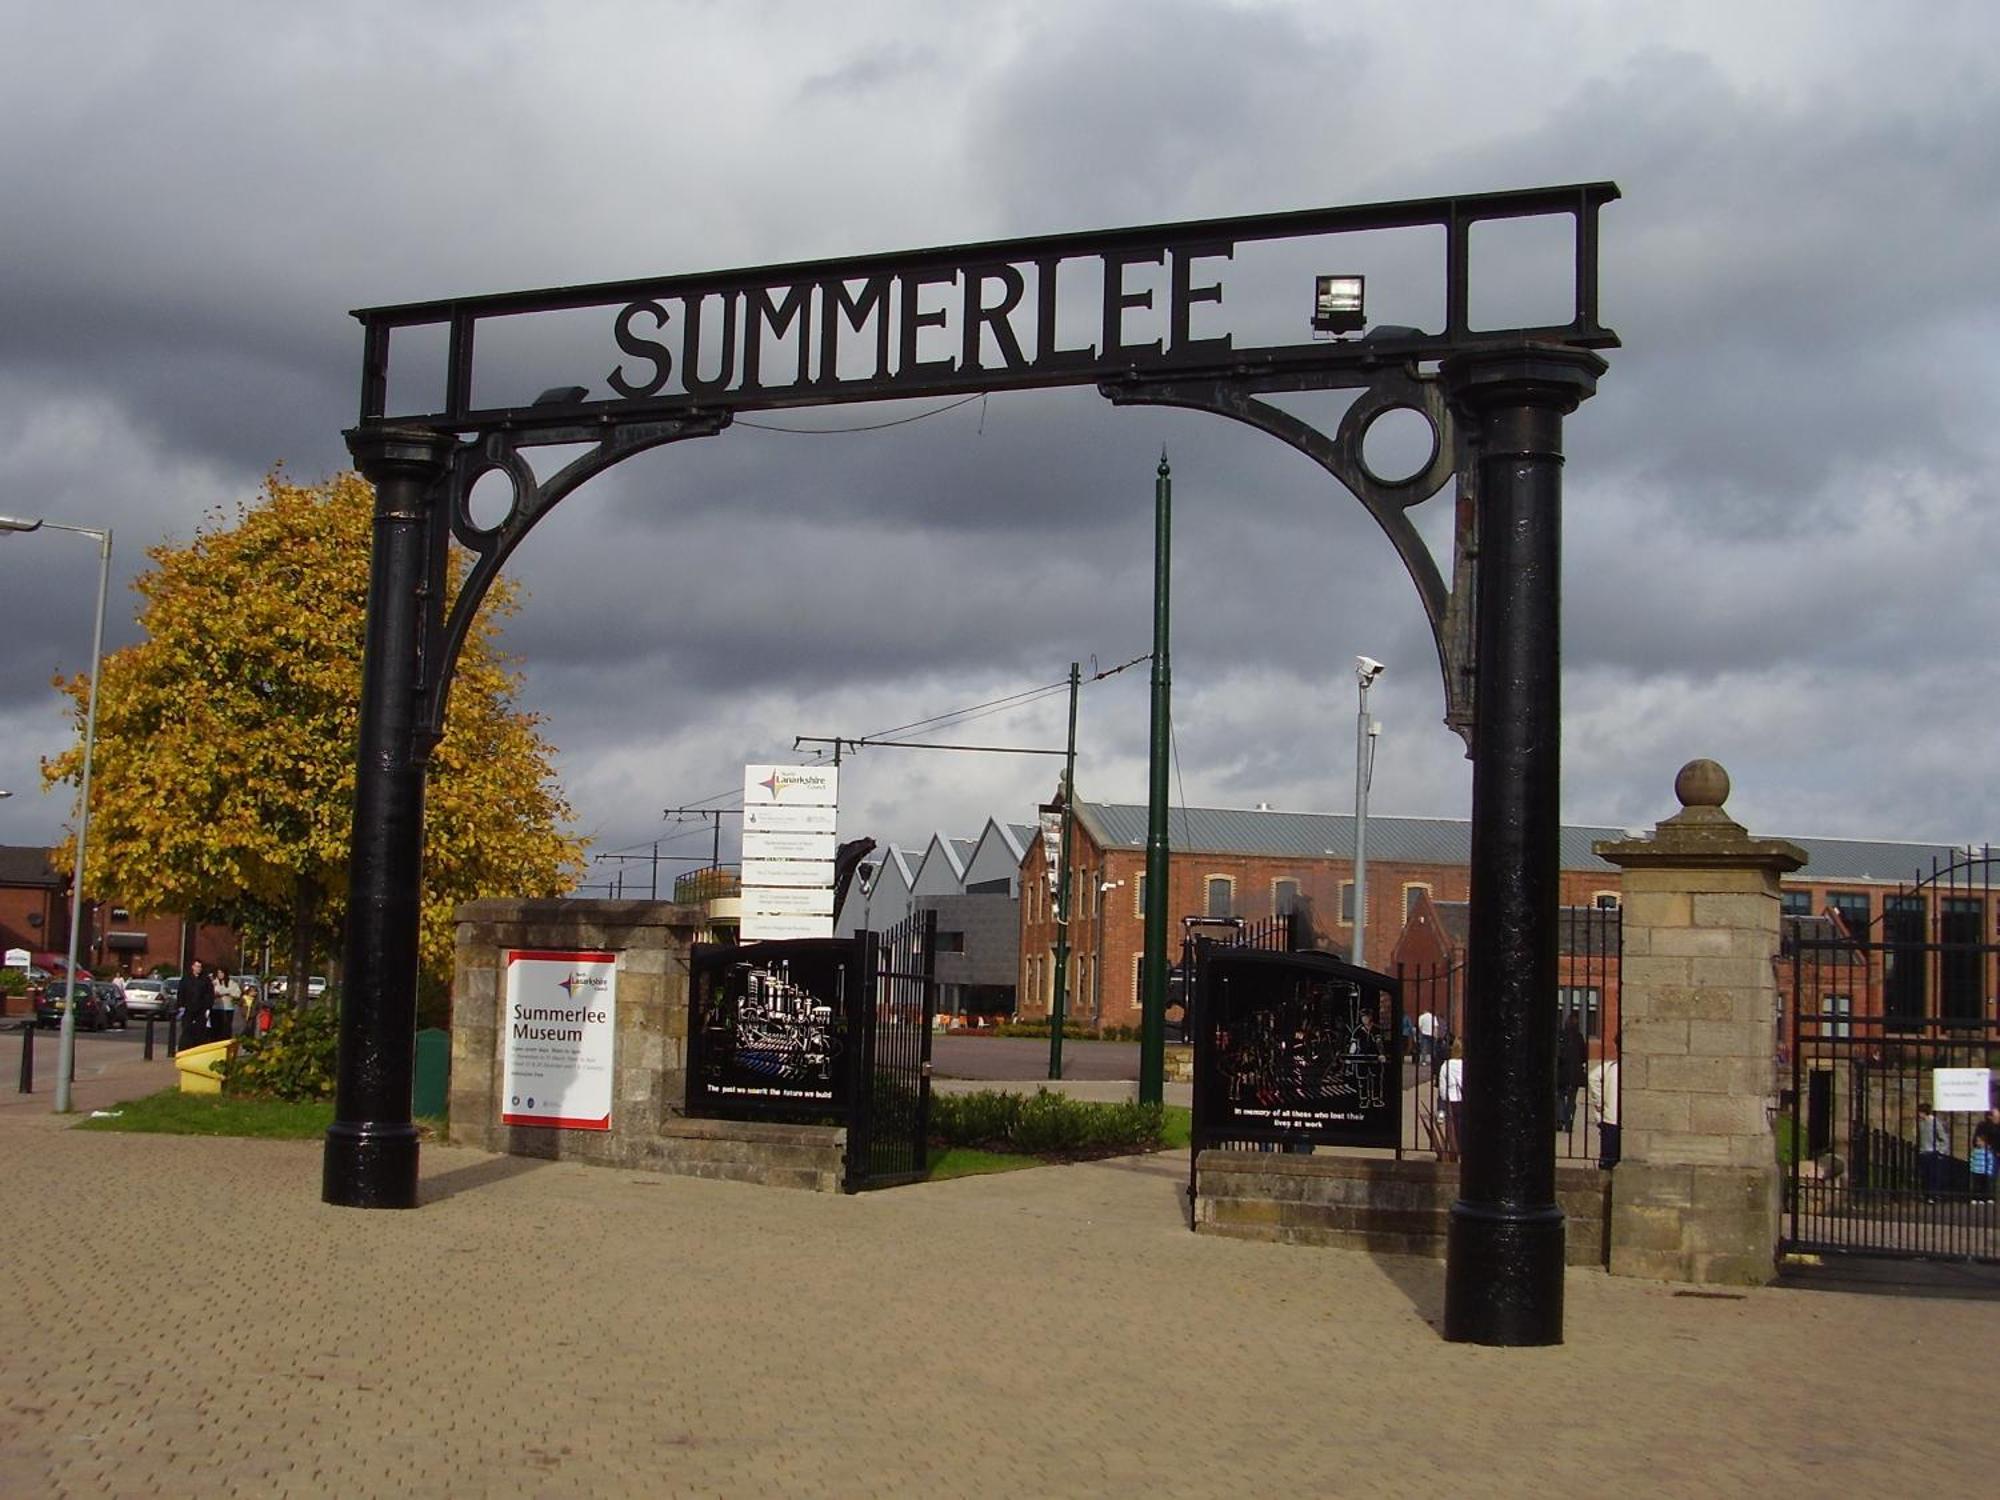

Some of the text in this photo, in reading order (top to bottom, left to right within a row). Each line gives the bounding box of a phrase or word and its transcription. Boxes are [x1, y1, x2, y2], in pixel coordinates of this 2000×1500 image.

[607, 242, 1234, 398] SUMMERLEE
[514, 1004, 606, 1023] Summerlee
[513, 1024, 582, 1041] Museum
[707, 1084, 719, 1092] The
[722, 1086, 736, 1094] past
[783, 1088, 803, 1097] future
[816, 1091, 832, 1099] build
[1234, 1107, 1241, 1115] In
[1243, 1108, 1271, 1117] memory
[1272, 1109, 1280, 1117] of
[1314, 1111, 1329, 1119] who
[1330, 1112, 1345, 1120] lost
[1347, 1112, 1365, 1120] their
